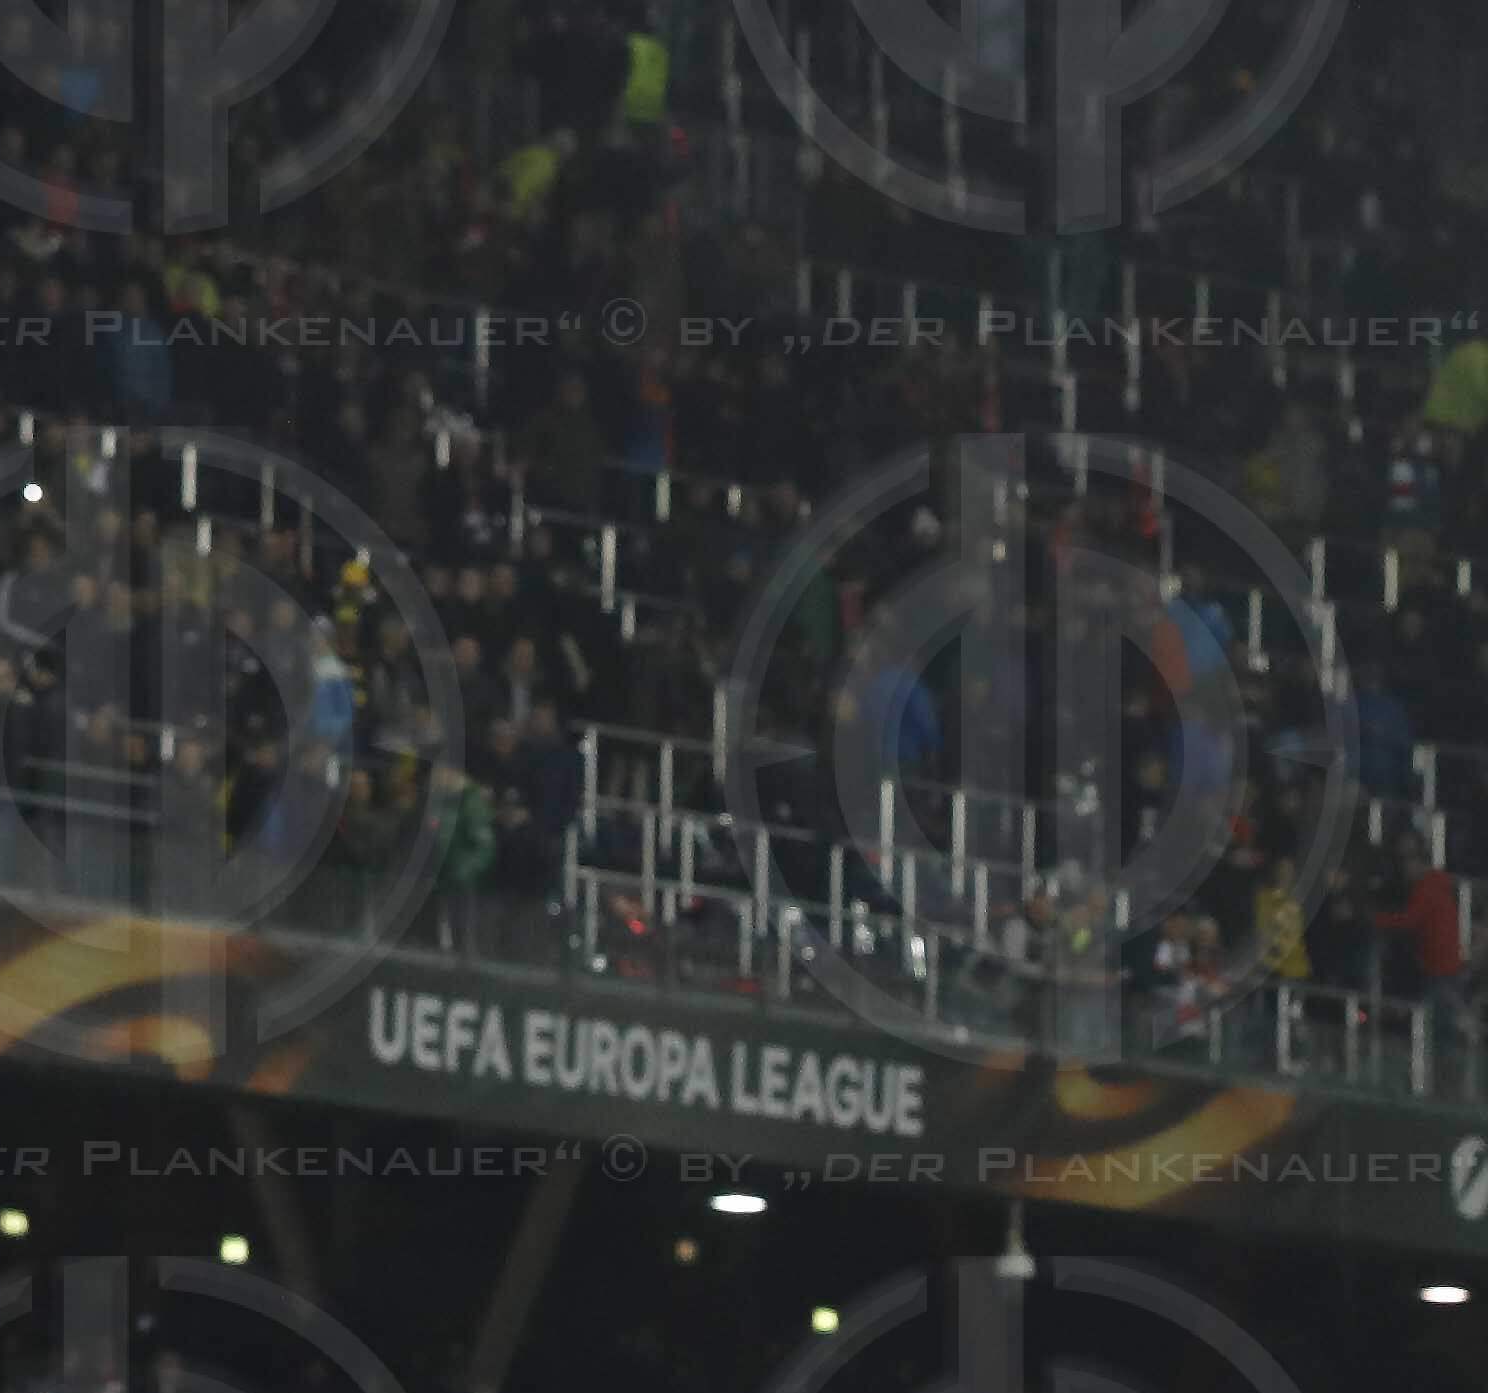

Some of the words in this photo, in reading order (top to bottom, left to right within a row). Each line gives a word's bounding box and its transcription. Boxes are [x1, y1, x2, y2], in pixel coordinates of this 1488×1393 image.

[367, 988, 513, 1081] UEFA
[521, 1010, 718, 1110] EUROPA
[729, 1041, 927, 1138] LEAGUE
